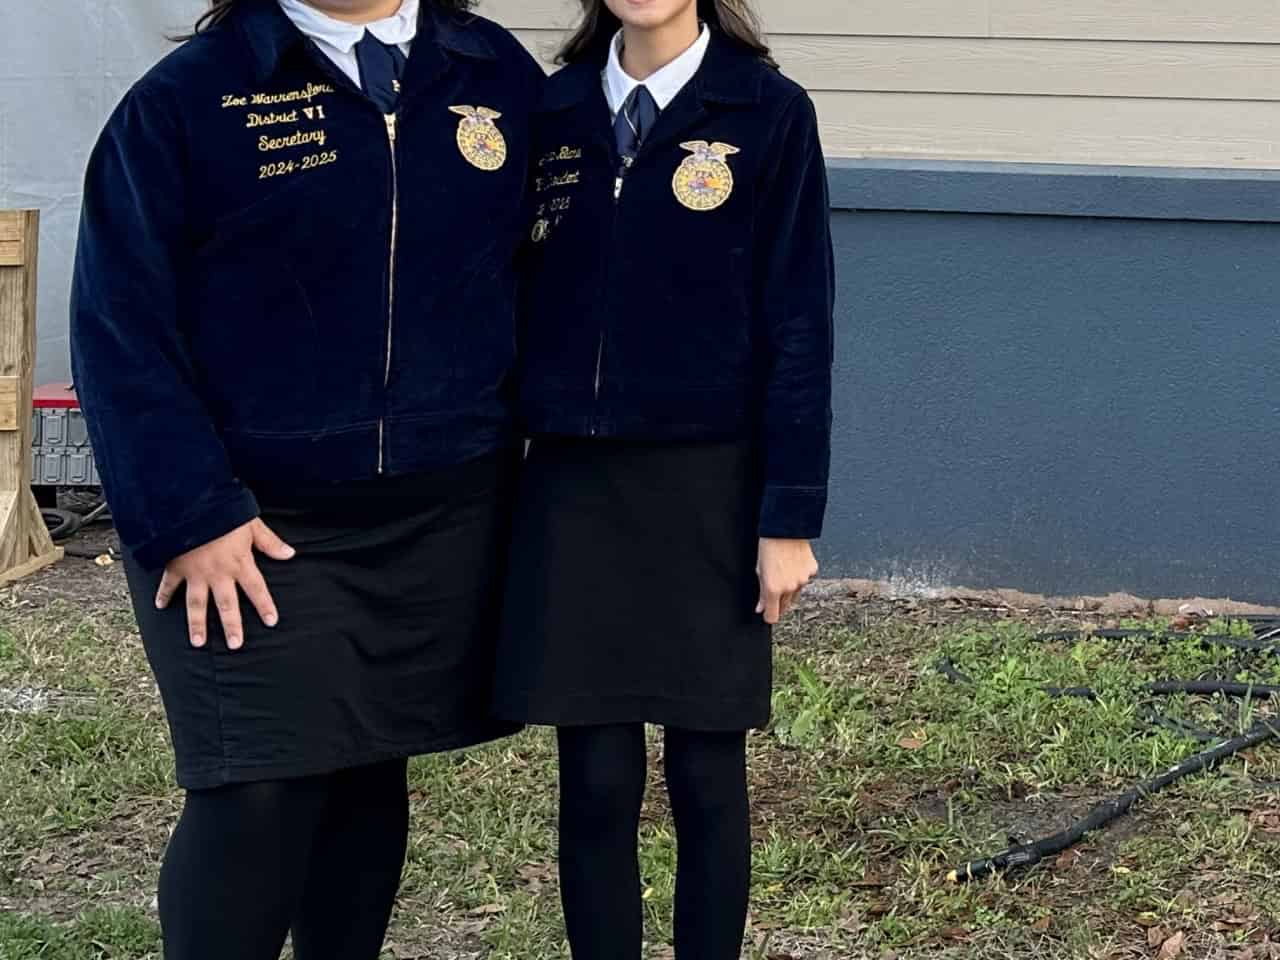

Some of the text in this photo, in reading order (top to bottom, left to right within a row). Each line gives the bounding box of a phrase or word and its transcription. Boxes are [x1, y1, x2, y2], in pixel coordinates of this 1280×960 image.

[221, 94, 248, 108] Zoe
[246, 105, 326, 128] District VI
[258, 129, 327, 151] Secretary
[258, 150, 337, 179] 2024-2025
